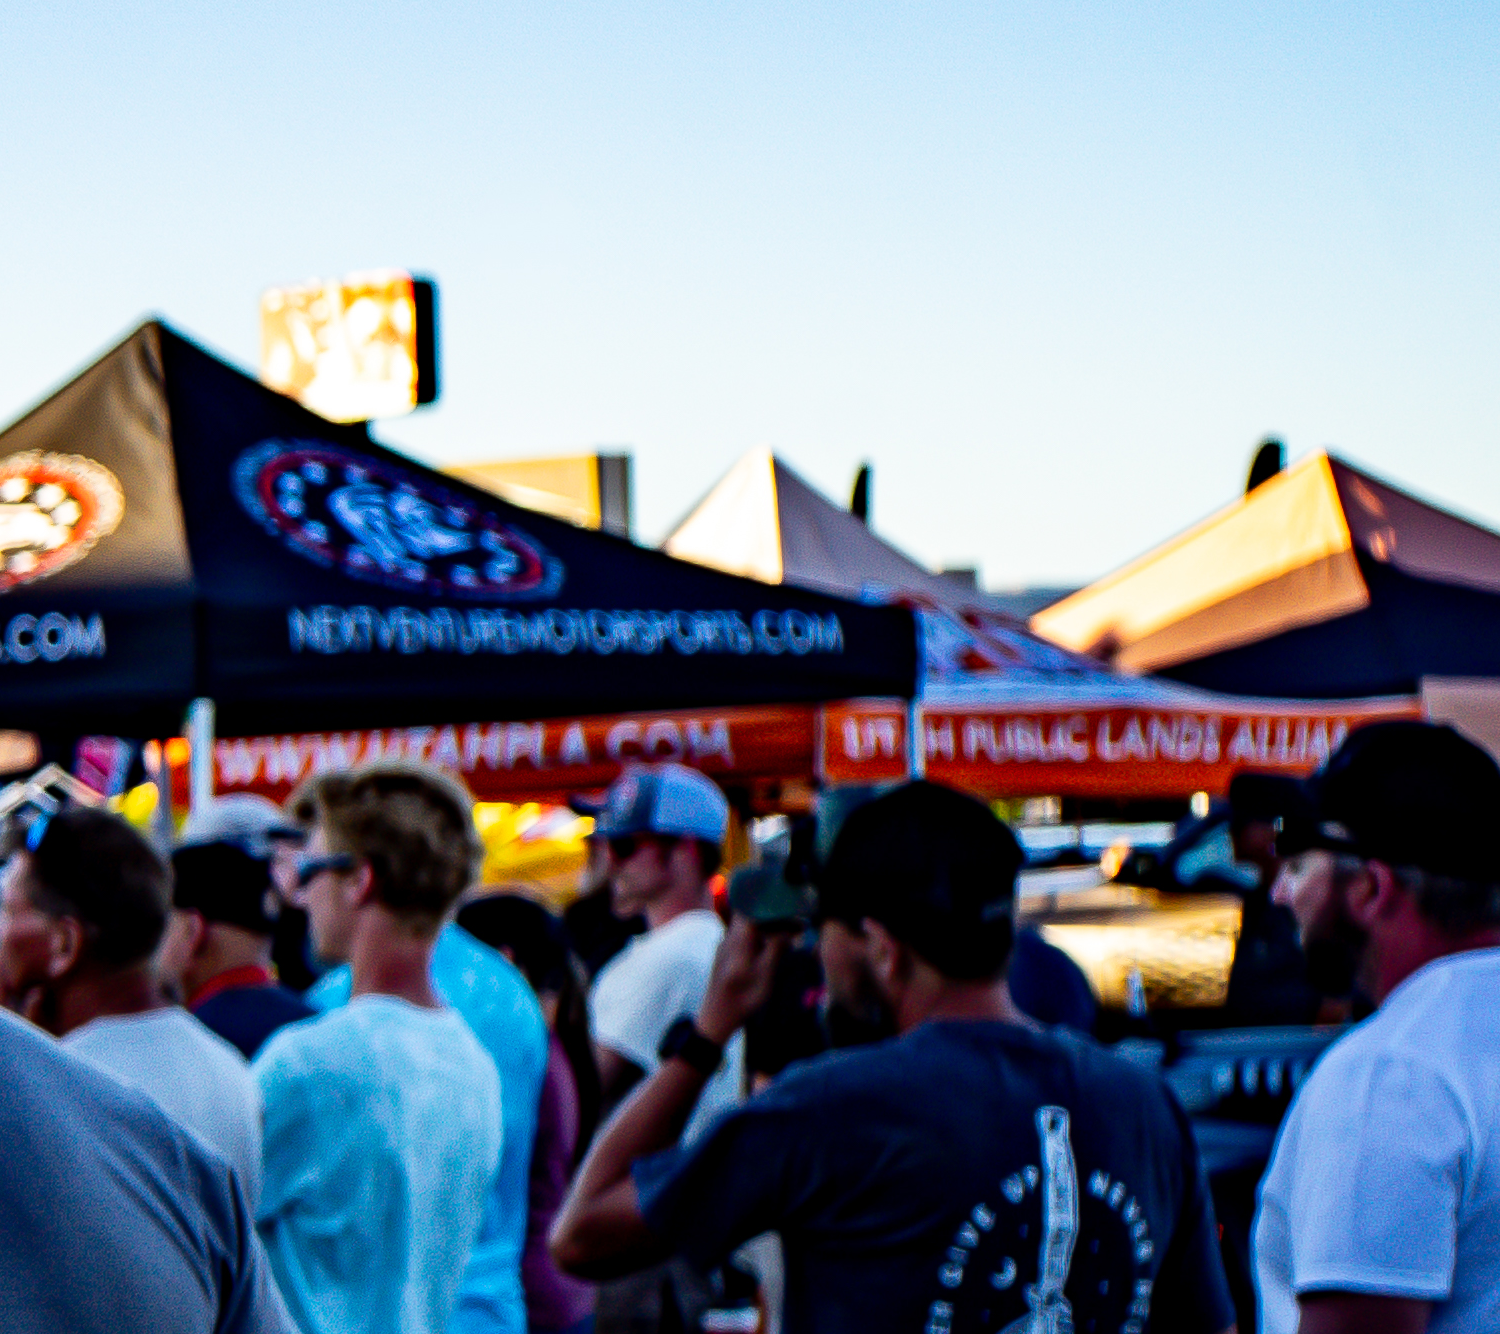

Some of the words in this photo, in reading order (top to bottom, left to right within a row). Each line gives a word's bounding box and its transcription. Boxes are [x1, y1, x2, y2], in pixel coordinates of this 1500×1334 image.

[287, 605, 844, 654] NEXTVENTUREMOTORSPORTS.COM
[842, 716, 954, 761] UTH
[962, 716, 1089, 762] PUBLIC
[1100, 715, 1220, 763] LANDS
[1227, 715, 1347, 763] ALLIA
[937, 1202, 997, 1289] GIVE
[1000, 1163, 1040, 1205] UP
